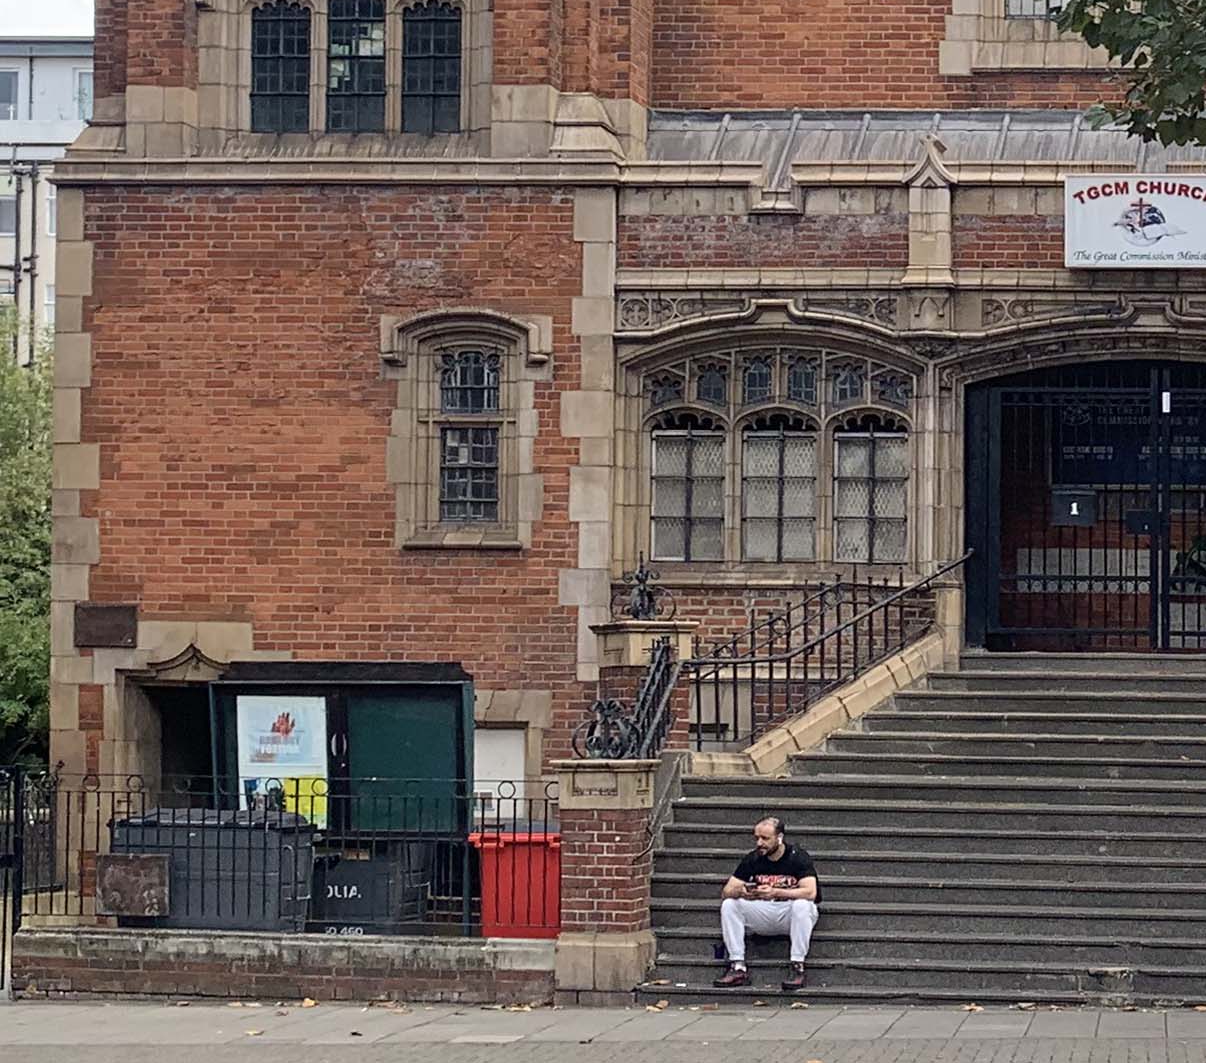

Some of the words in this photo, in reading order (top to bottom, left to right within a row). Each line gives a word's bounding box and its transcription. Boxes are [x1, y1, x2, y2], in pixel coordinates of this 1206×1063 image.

[1073, 181, 1129, 205] TGCM
[1074, 251, 1092, 261] The
[1093, 251, 1117, 264] Great
[1120, 251, 1175, 261] Commission
[1070, 502, 1079, 515] 1
